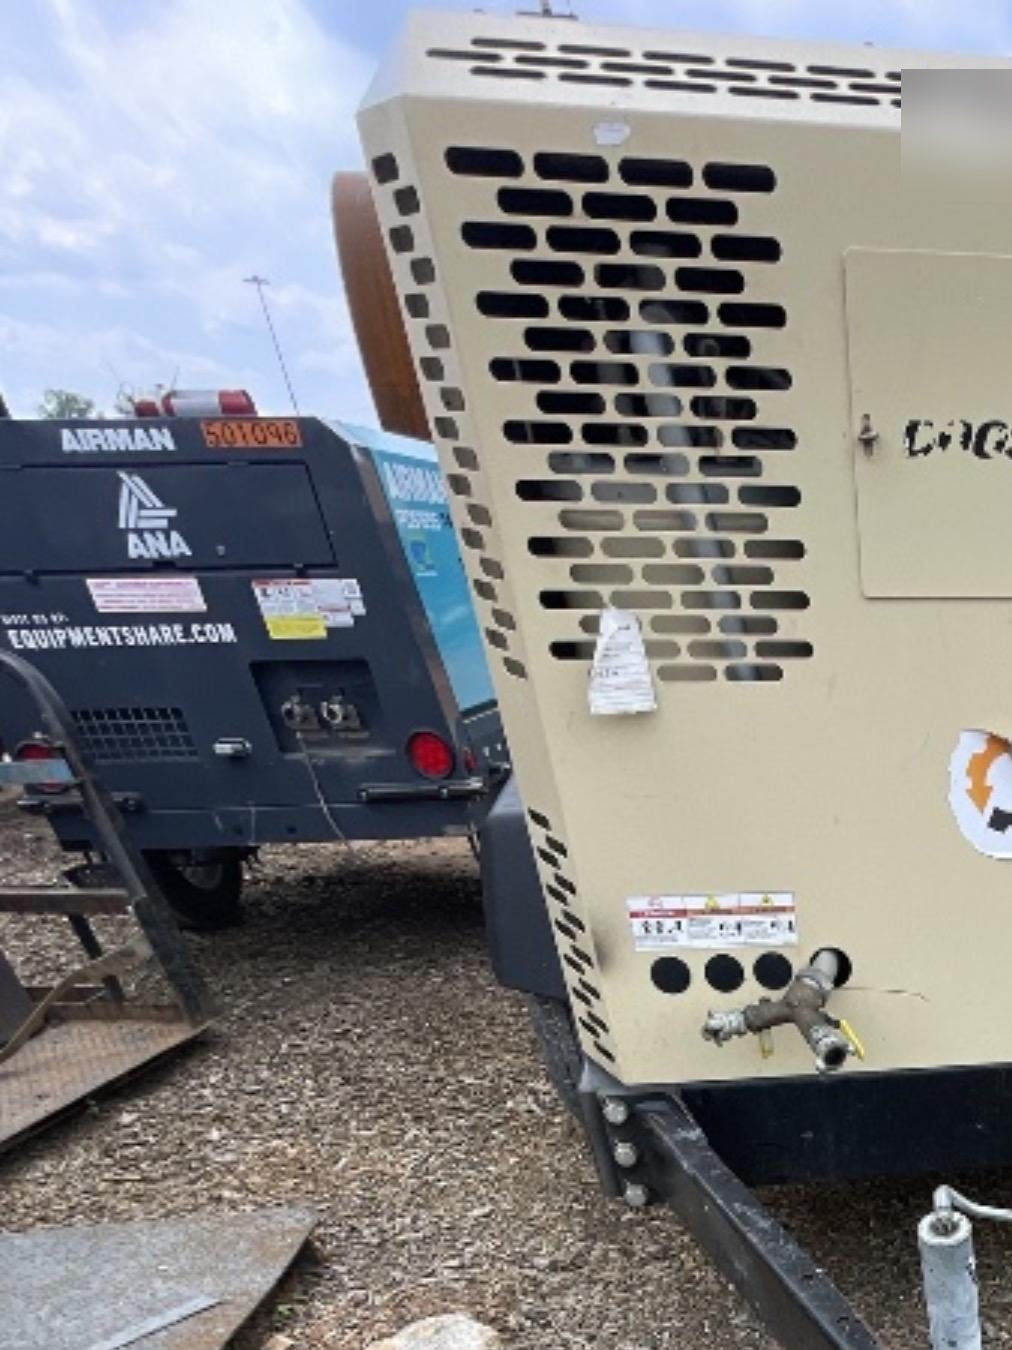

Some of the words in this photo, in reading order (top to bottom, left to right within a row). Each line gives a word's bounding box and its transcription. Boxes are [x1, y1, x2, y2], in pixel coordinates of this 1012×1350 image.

[60, 426, 176, 452] AIRMAN
[127, 530, 192, 558] ANA
[8, 623, 238, 650] EQUIPMENTSHARE.COM
